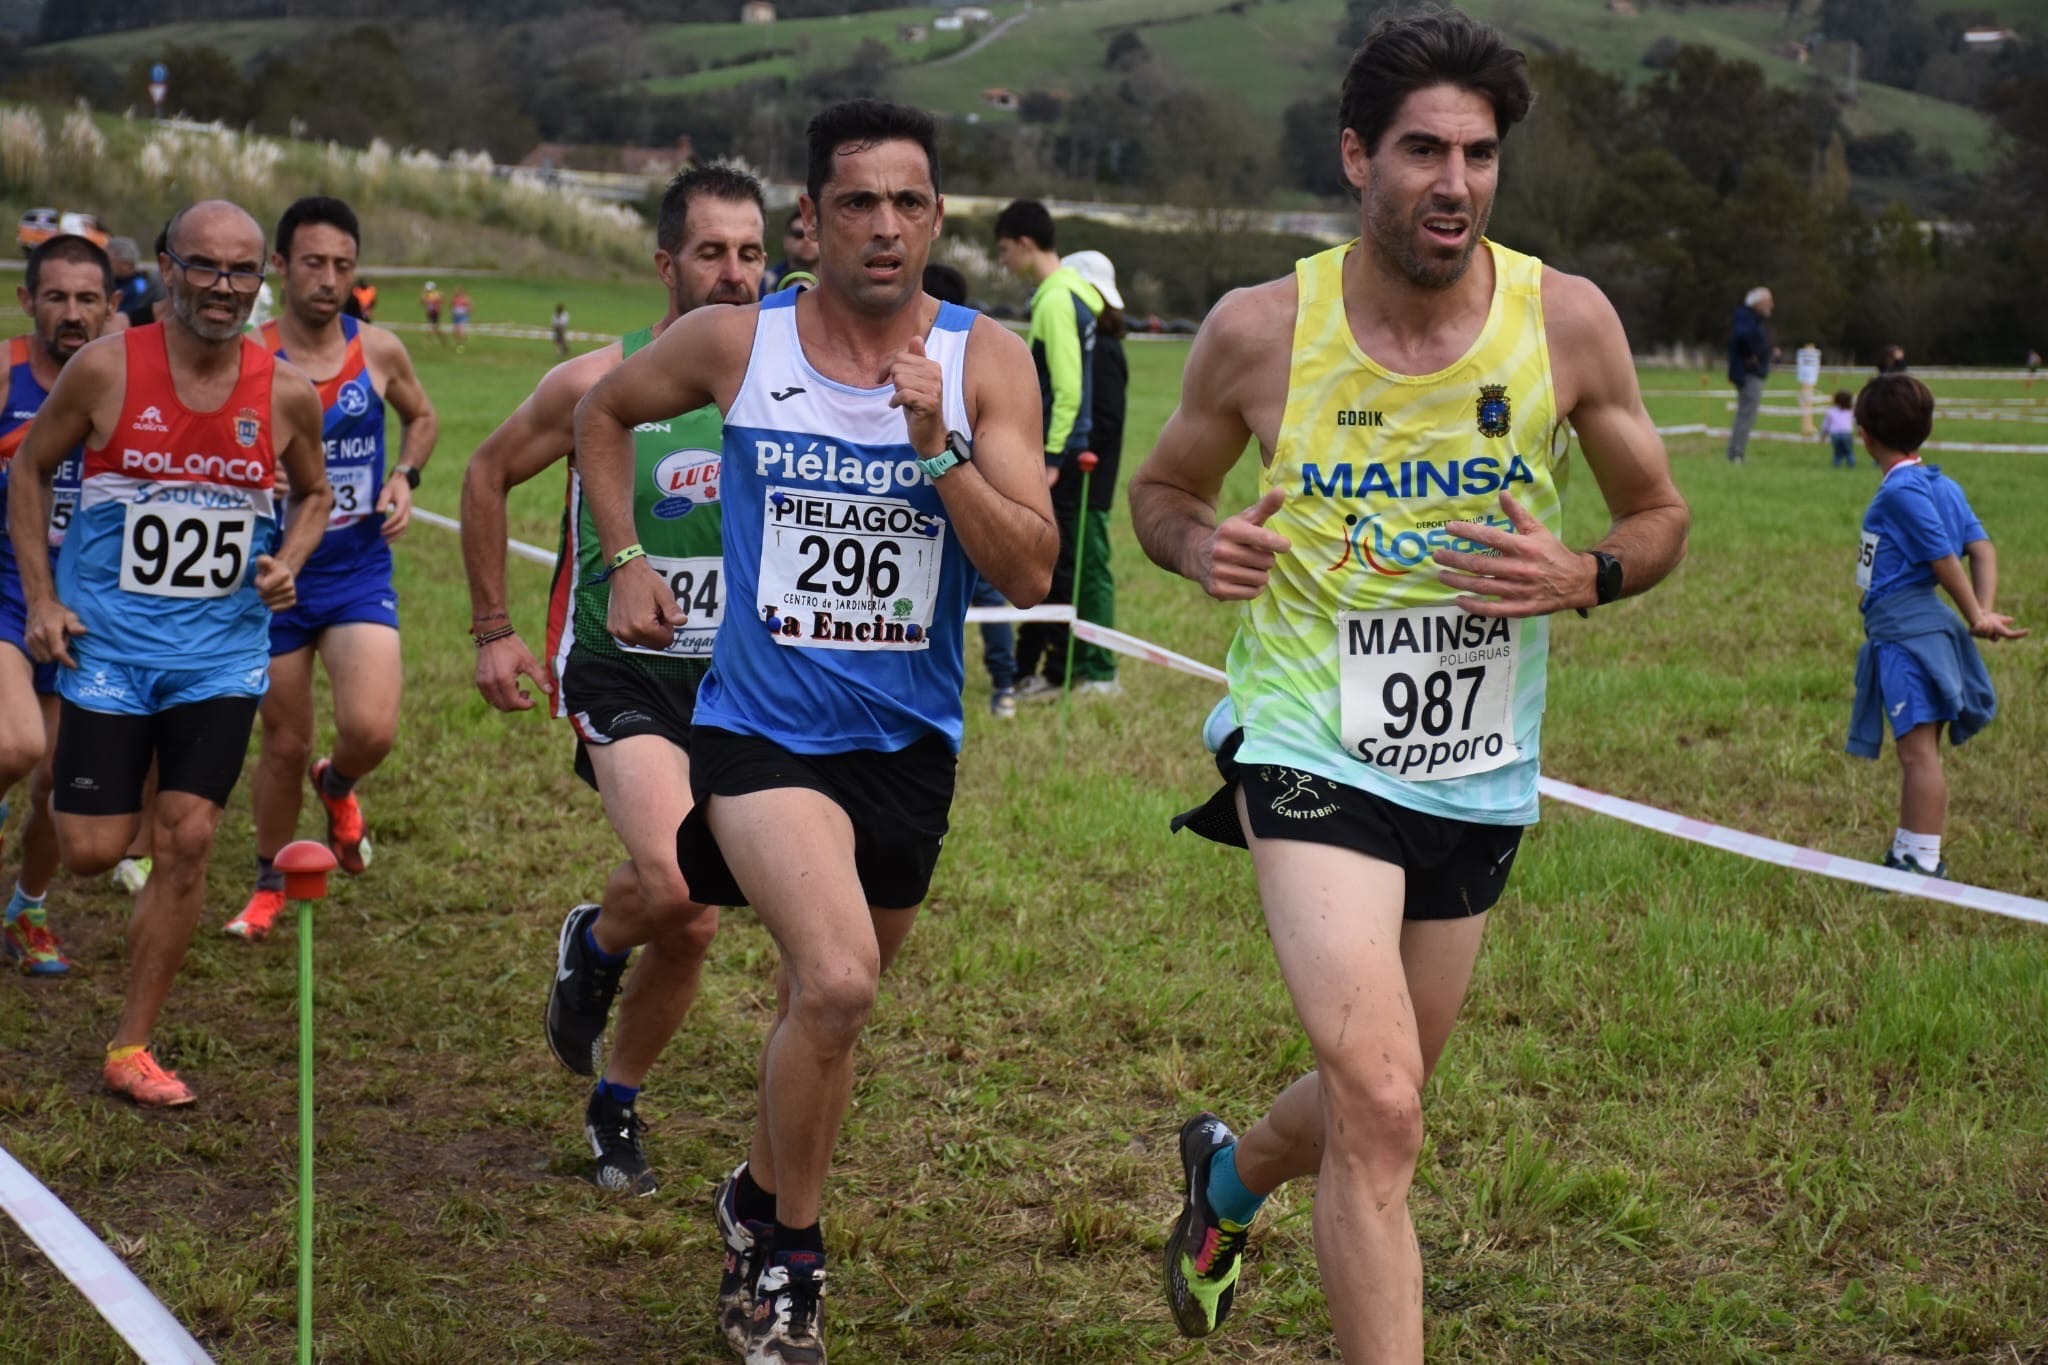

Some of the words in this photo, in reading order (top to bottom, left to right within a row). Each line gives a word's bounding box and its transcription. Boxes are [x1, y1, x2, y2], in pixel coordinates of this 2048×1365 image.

[1337, 410, 1384, 427] GOBIK
[340, 435, 377, 460] NOJA
[755, 441, 934, 495] Piélago
[1302, 454, 1534, 498] MAINSA
[775, 497, 934, 536] PIELAGOS
[132, 514, 245, 589] 925
[796, 534, 902, 598] 296
[652, 570, 719, 619] 84
[783, 593, 818, 608] CENTRO
[822, 599, 832, 609] de
[1348, 615, 1511, 656] MAINSA
[1440, 645, 1511, 667] POLIGRUAS
[1382, 665, 1486, 740] 987
[1357, 732, 1503, 775] Sapporo
